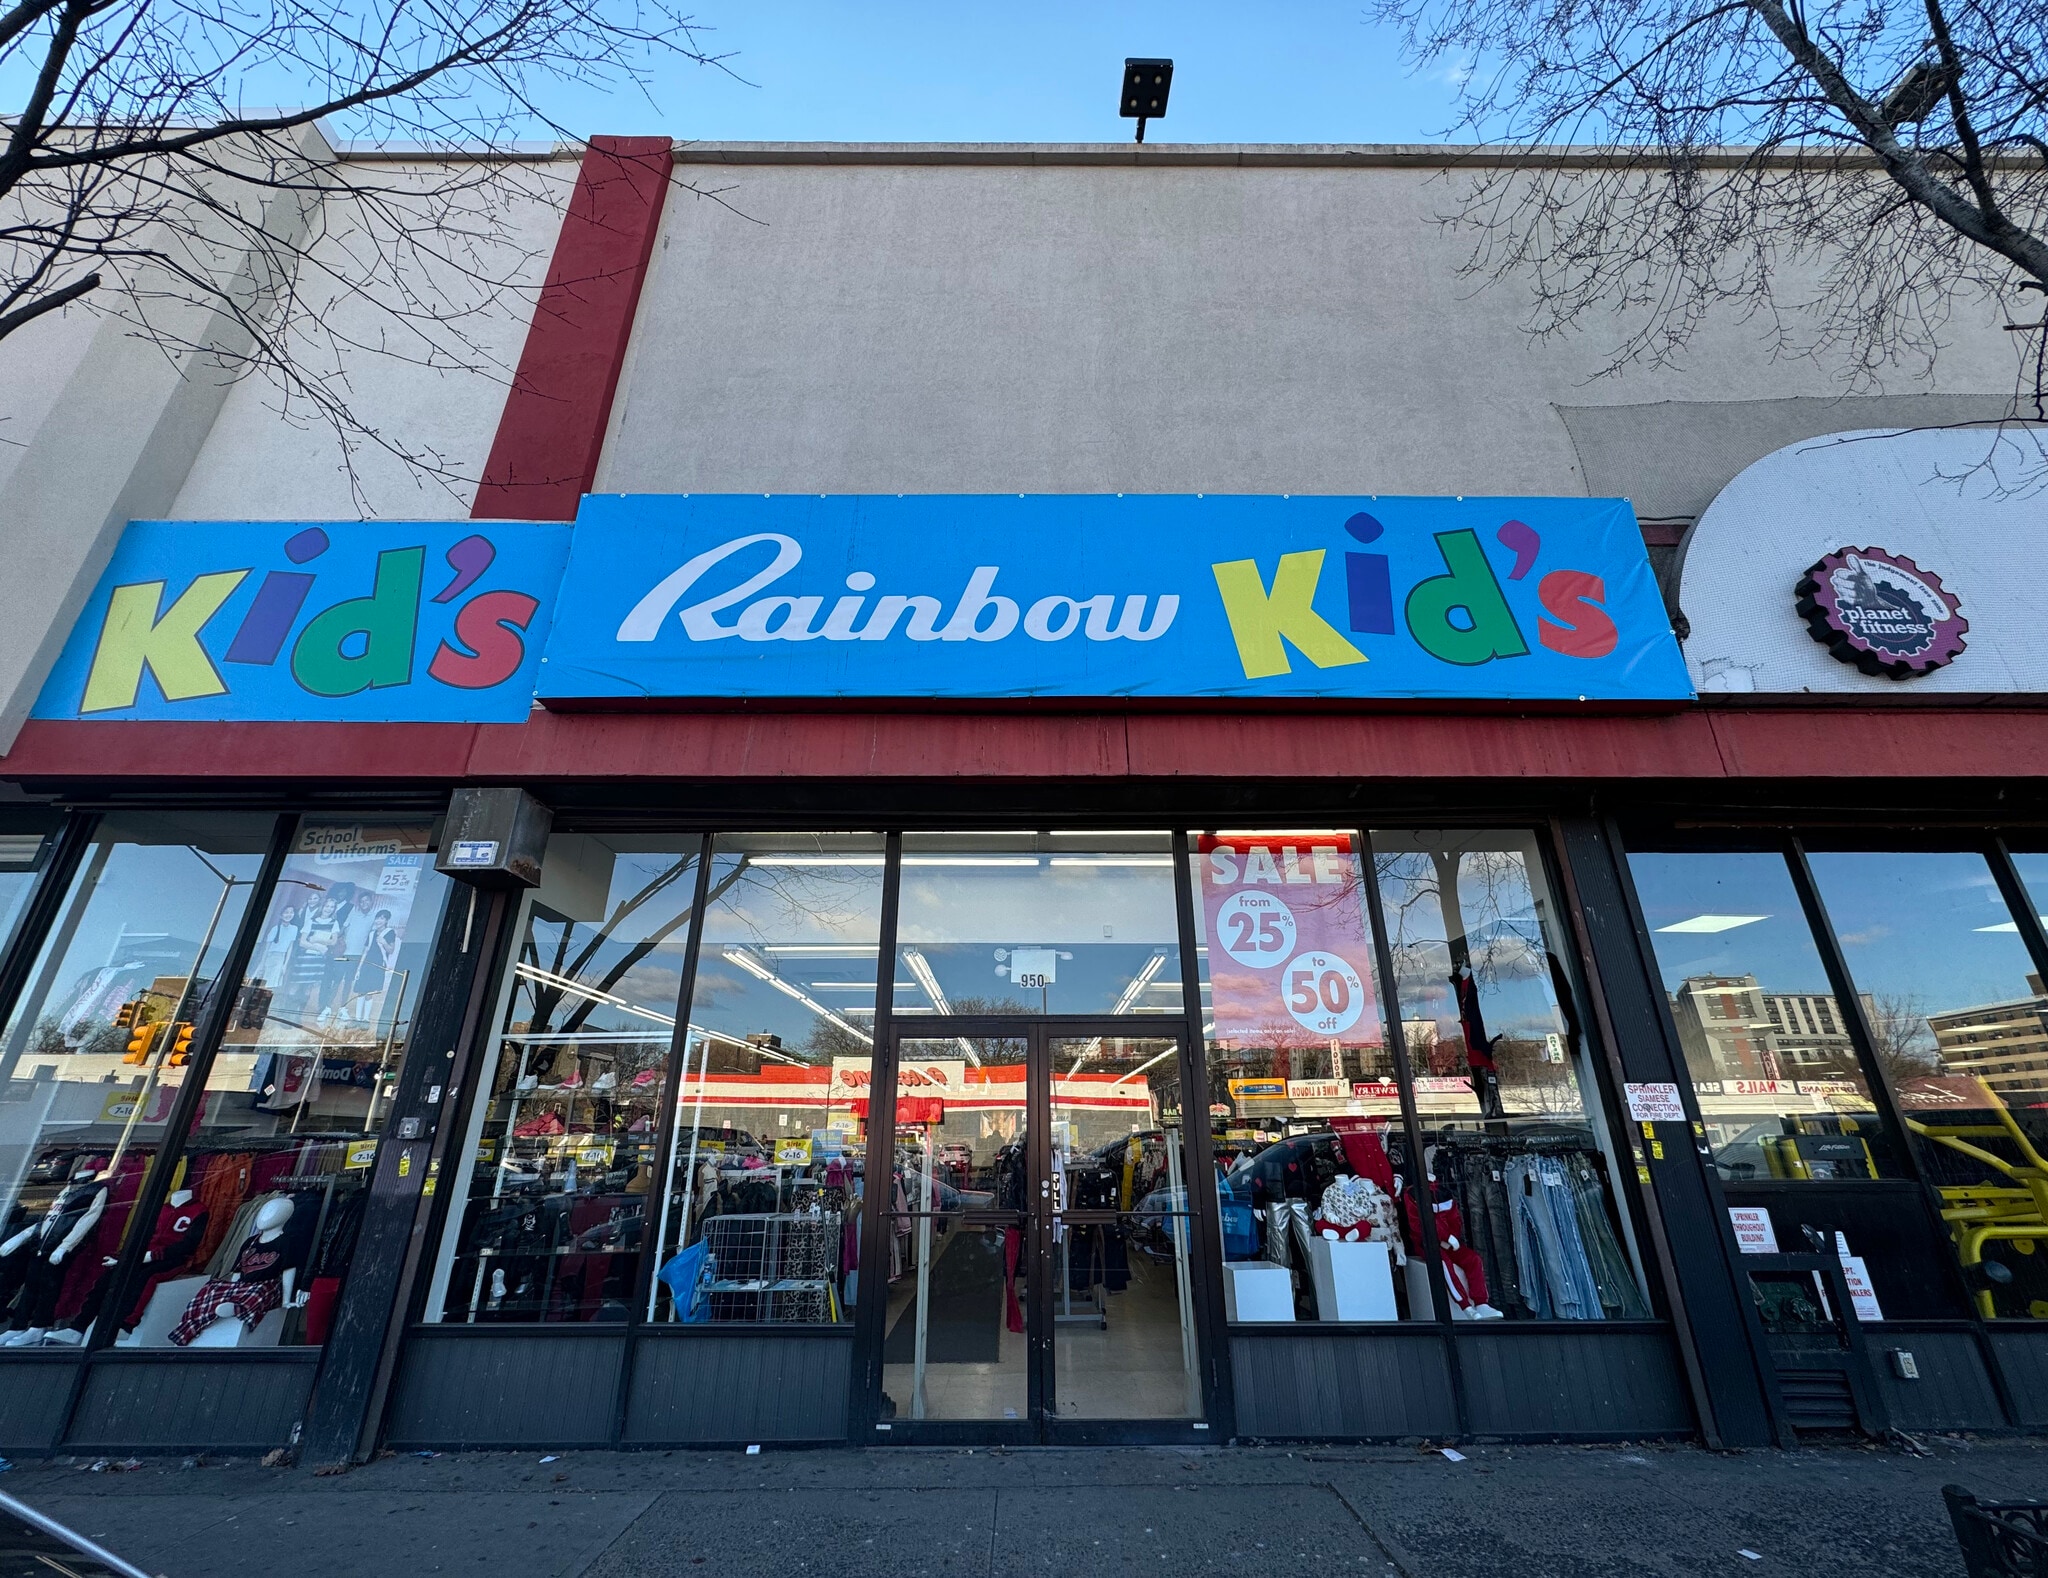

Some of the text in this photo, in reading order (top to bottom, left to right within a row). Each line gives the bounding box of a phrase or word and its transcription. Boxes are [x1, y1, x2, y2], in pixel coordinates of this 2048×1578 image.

[615, 511, 1620, 680] Rainbow Kid's
[78, 526, 541, 715] Kid's
[1845, 606, 1911, 623] planet
[1860, 620, 1928, 634] fitness
[304, 827, 359, 846] School
[319, 843, 396, 860] Uniforms
[387, 856, 417, 865] SALE!
[1209, 845, 1343, 885] SALE
[1239, 895, 1271, 907] from
[1312, 956, 1326, 967] to
[1021, 974, 1045, 987] 950
[1318, 1017, 1338, 1030] off
[1628, 1084, 1676, 1094] SPRINKLER
[1638, 1094, 1671, 1103] SIAMESE
[784, 1150, 801, 1159] 7-16
[1053, 1173, 1061, 1210] PULL
